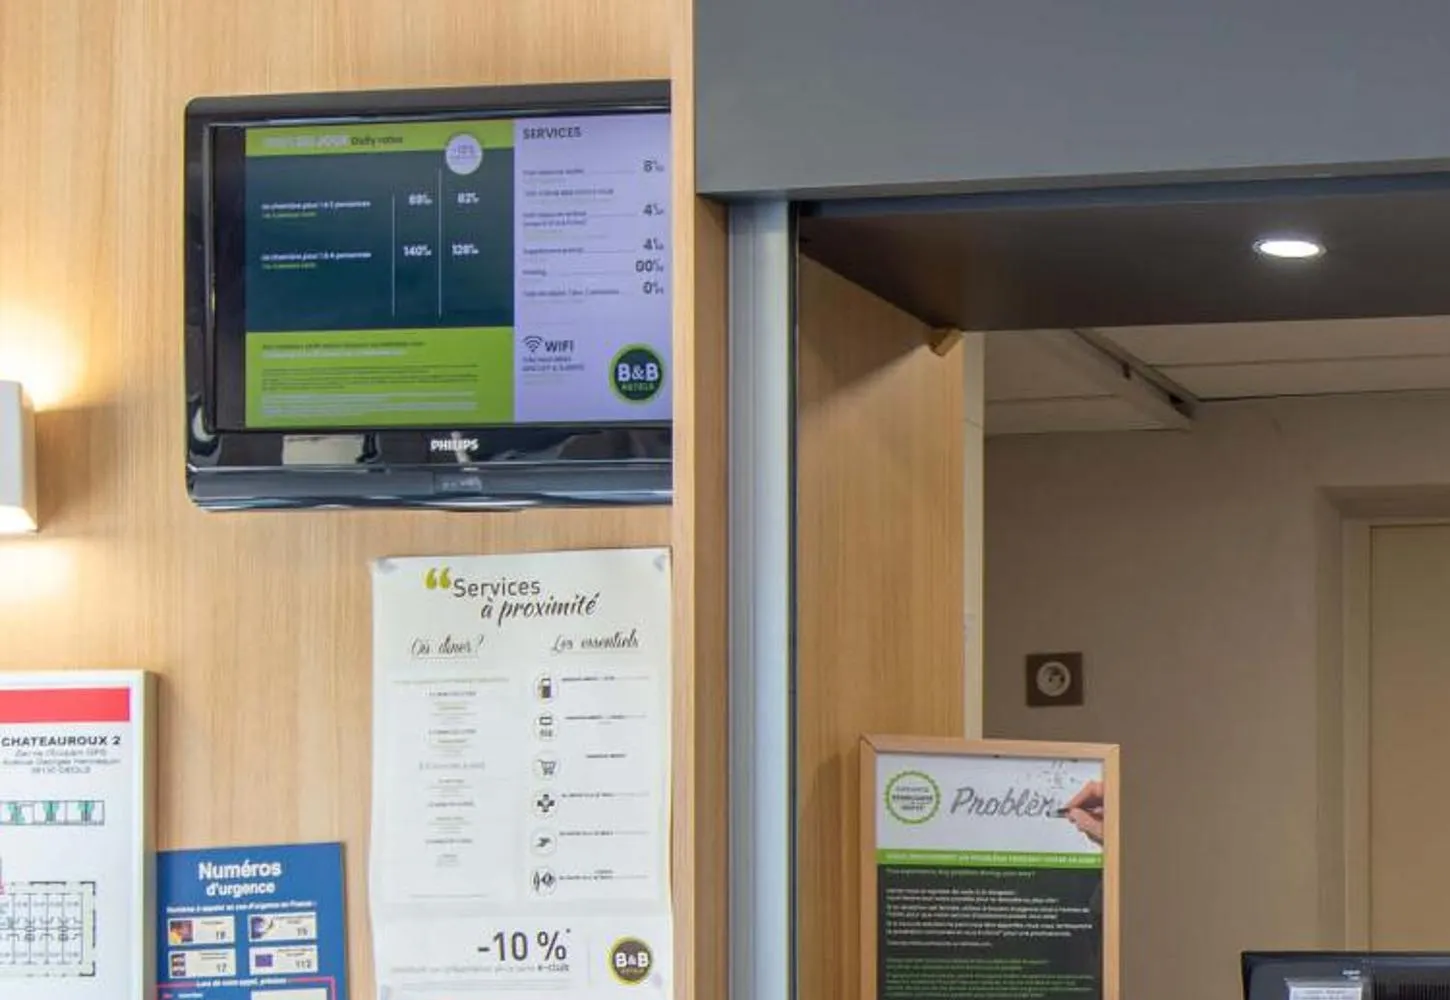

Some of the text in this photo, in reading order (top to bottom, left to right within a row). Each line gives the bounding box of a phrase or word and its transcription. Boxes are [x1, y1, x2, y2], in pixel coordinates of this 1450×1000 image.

[522, 127, 582, 140] SERVICES
[544, 339, 575, 353] WIFI
[617, 363, 659, 382] B&B
[430, 438, 480, 452] PHILIPS
[453, 577, 541, 598] Services
[480, 591, 600, 628] à proximité
[1, 735, 121, 747] CHATEAUROUX 2
[198, 860, 283, 880] Numéros
[206, 881, 276, 898] d'urgence
[477, 931, 529, 961] -10
[615, 952, 649, 968] B&B
